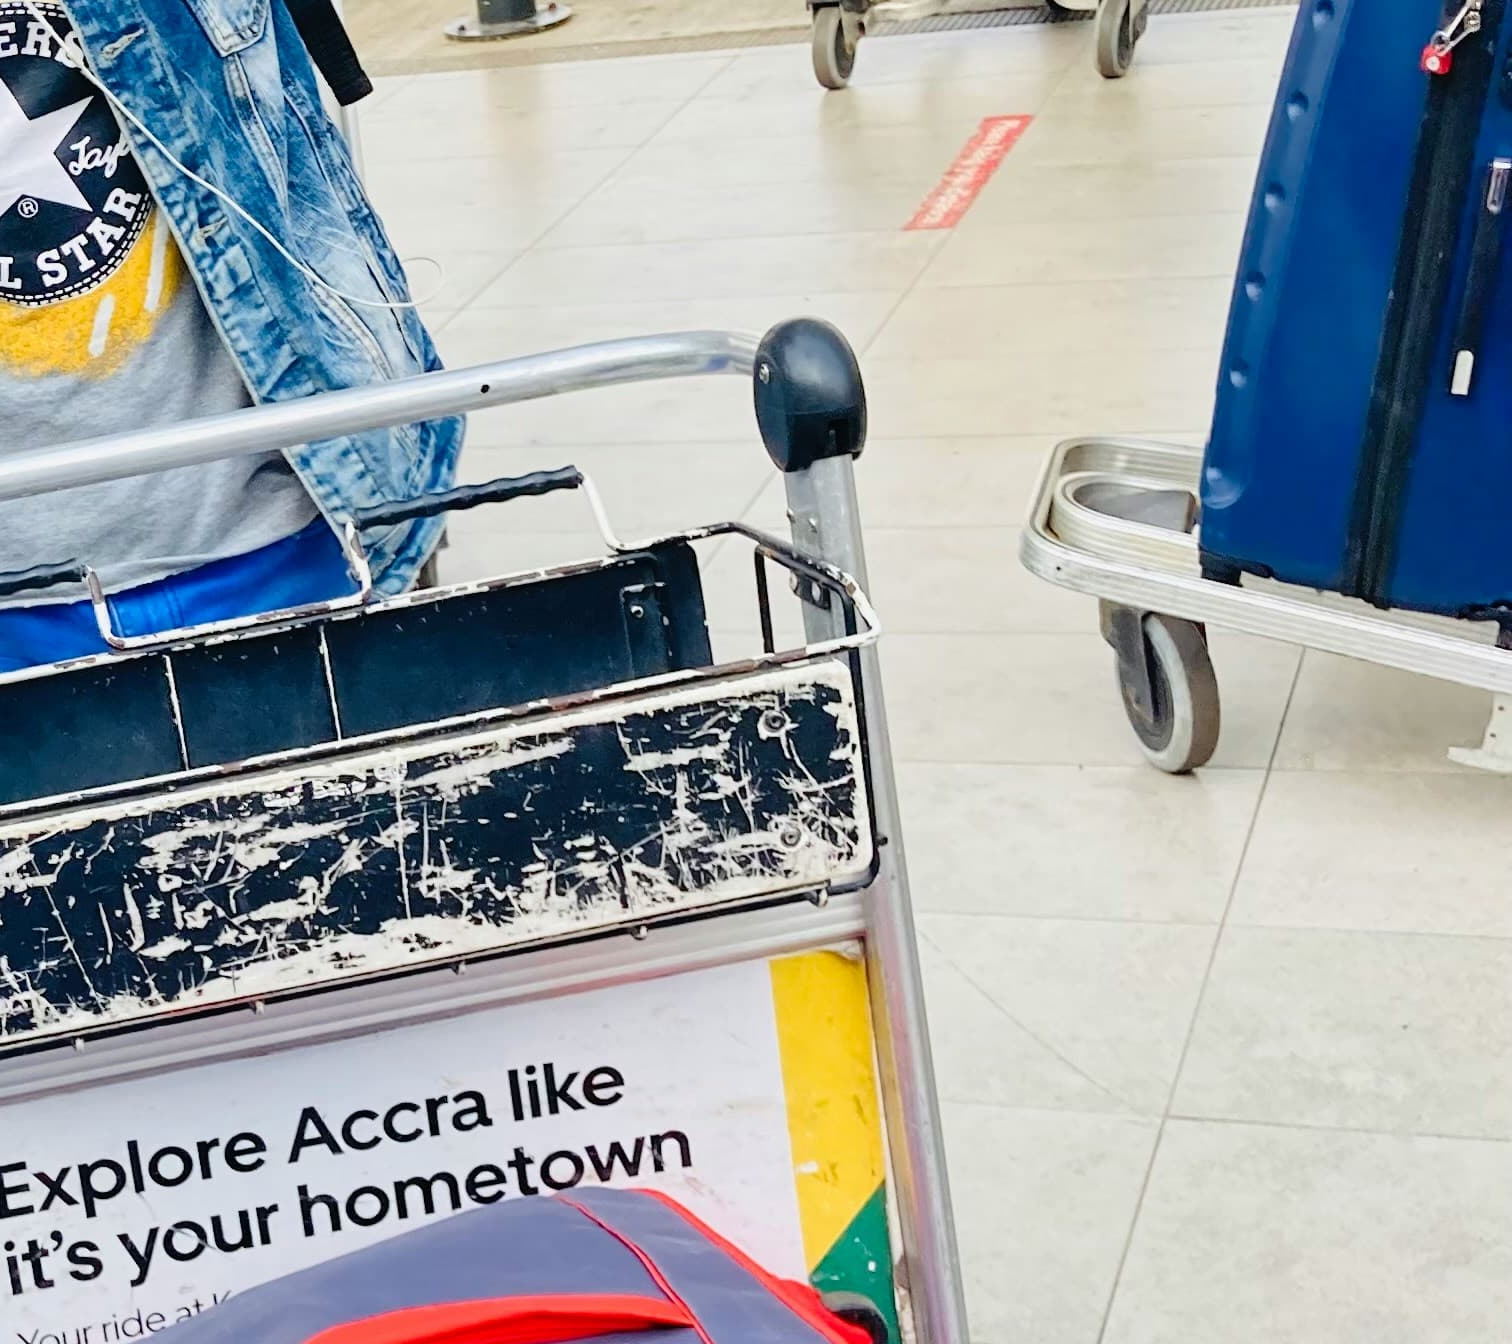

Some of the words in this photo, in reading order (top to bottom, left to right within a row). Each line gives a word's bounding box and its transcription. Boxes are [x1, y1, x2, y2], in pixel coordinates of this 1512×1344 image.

[36, 187, 142, 288] STAR
[288, 1089, 493, 1164] Accra
[507, 1062, 626, 1122] like
[4, 1229, 104, 1296] it’s
[117, 1203, 279, 1287] your
[297, 1129, 693, 1238] hometown
[102, 1308, 166, 1343] ride
